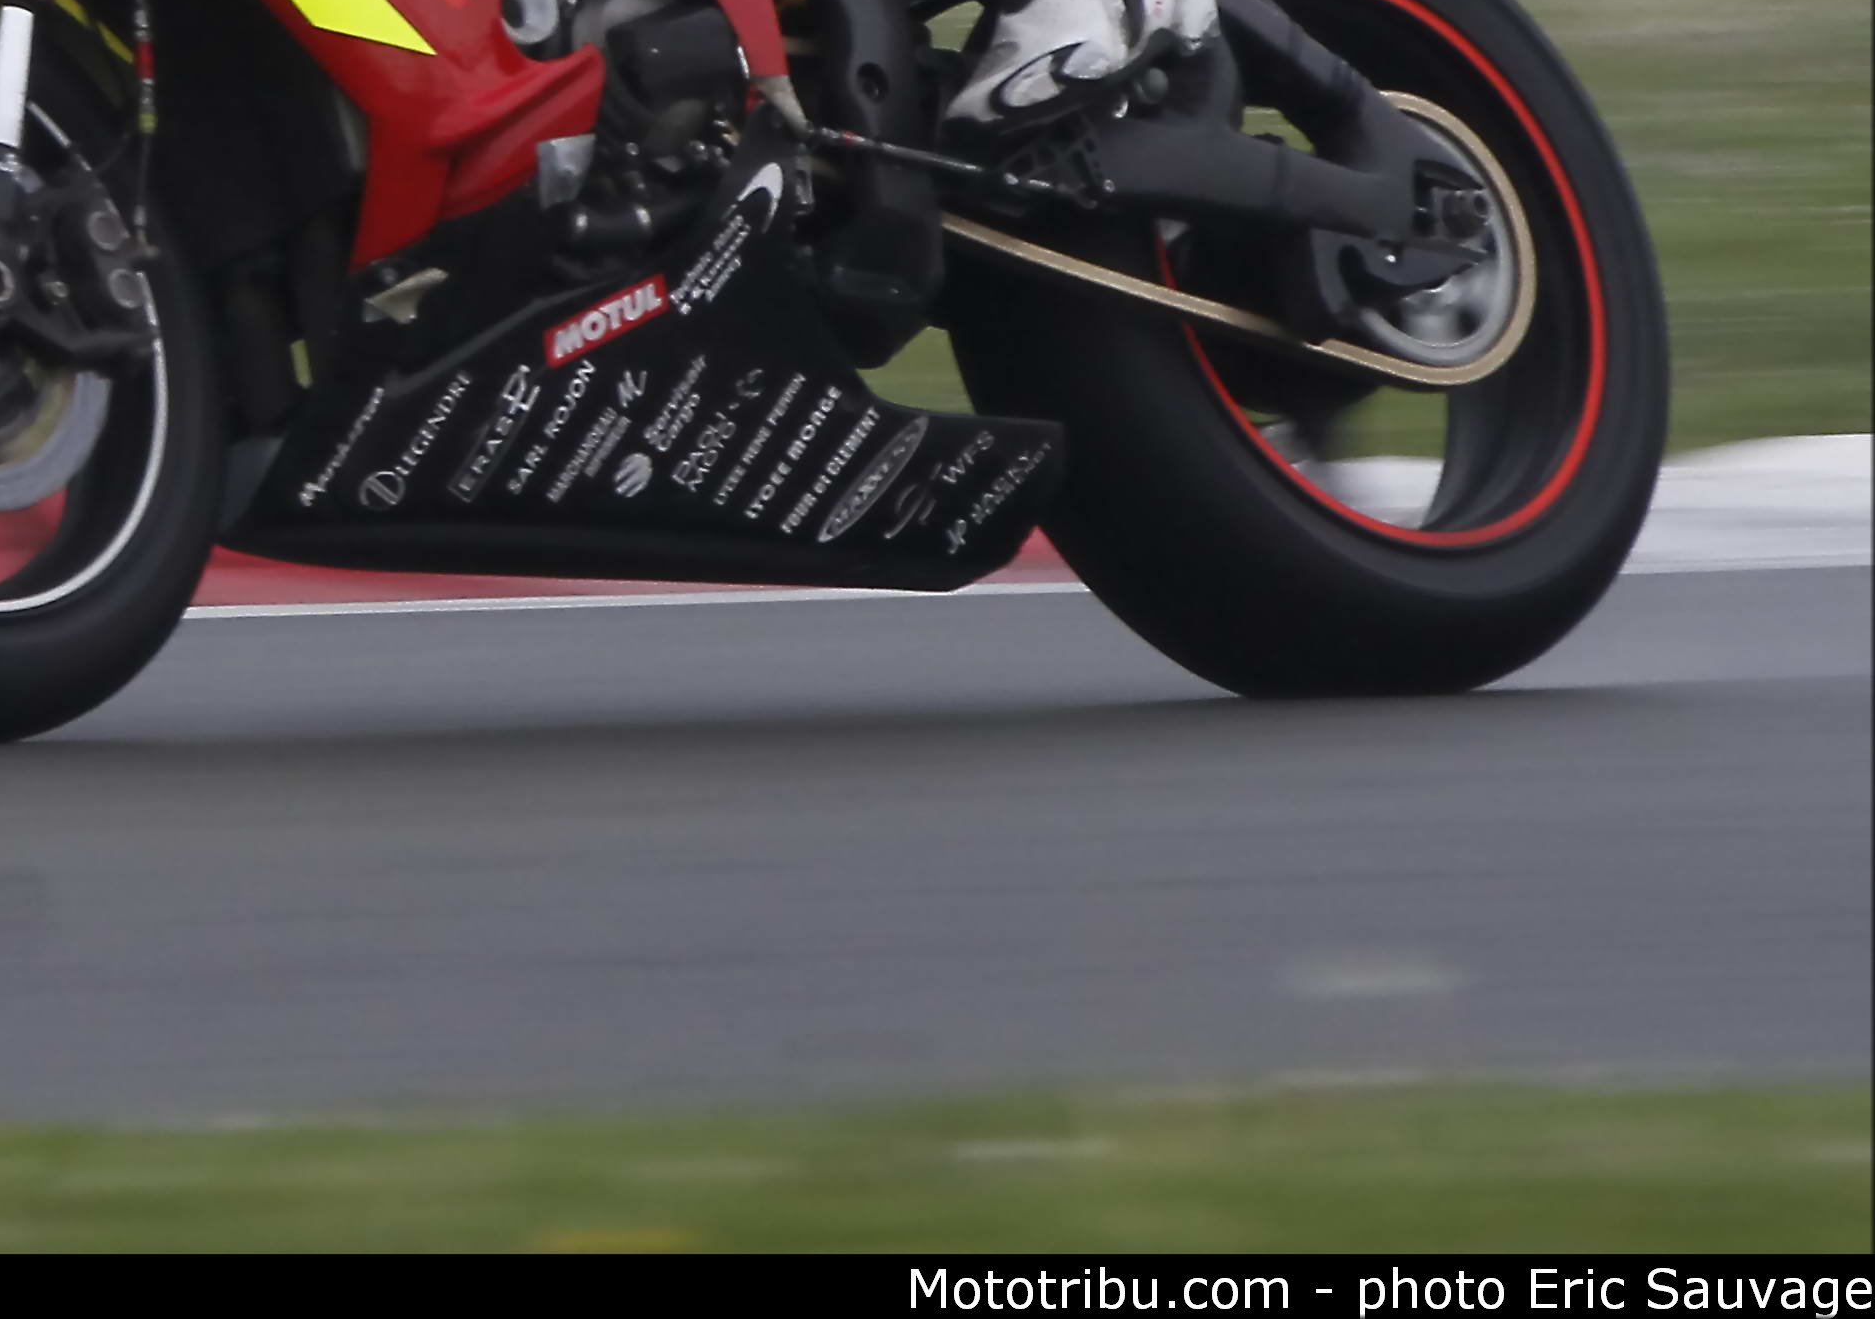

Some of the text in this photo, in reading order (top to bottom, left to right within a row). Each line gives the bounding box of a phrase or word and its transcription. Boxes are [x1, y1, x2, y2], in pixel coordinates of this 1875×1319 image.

[551, 284, 663, 359] MOTUL
[505, 358, 598, 496] SARL ROJON
